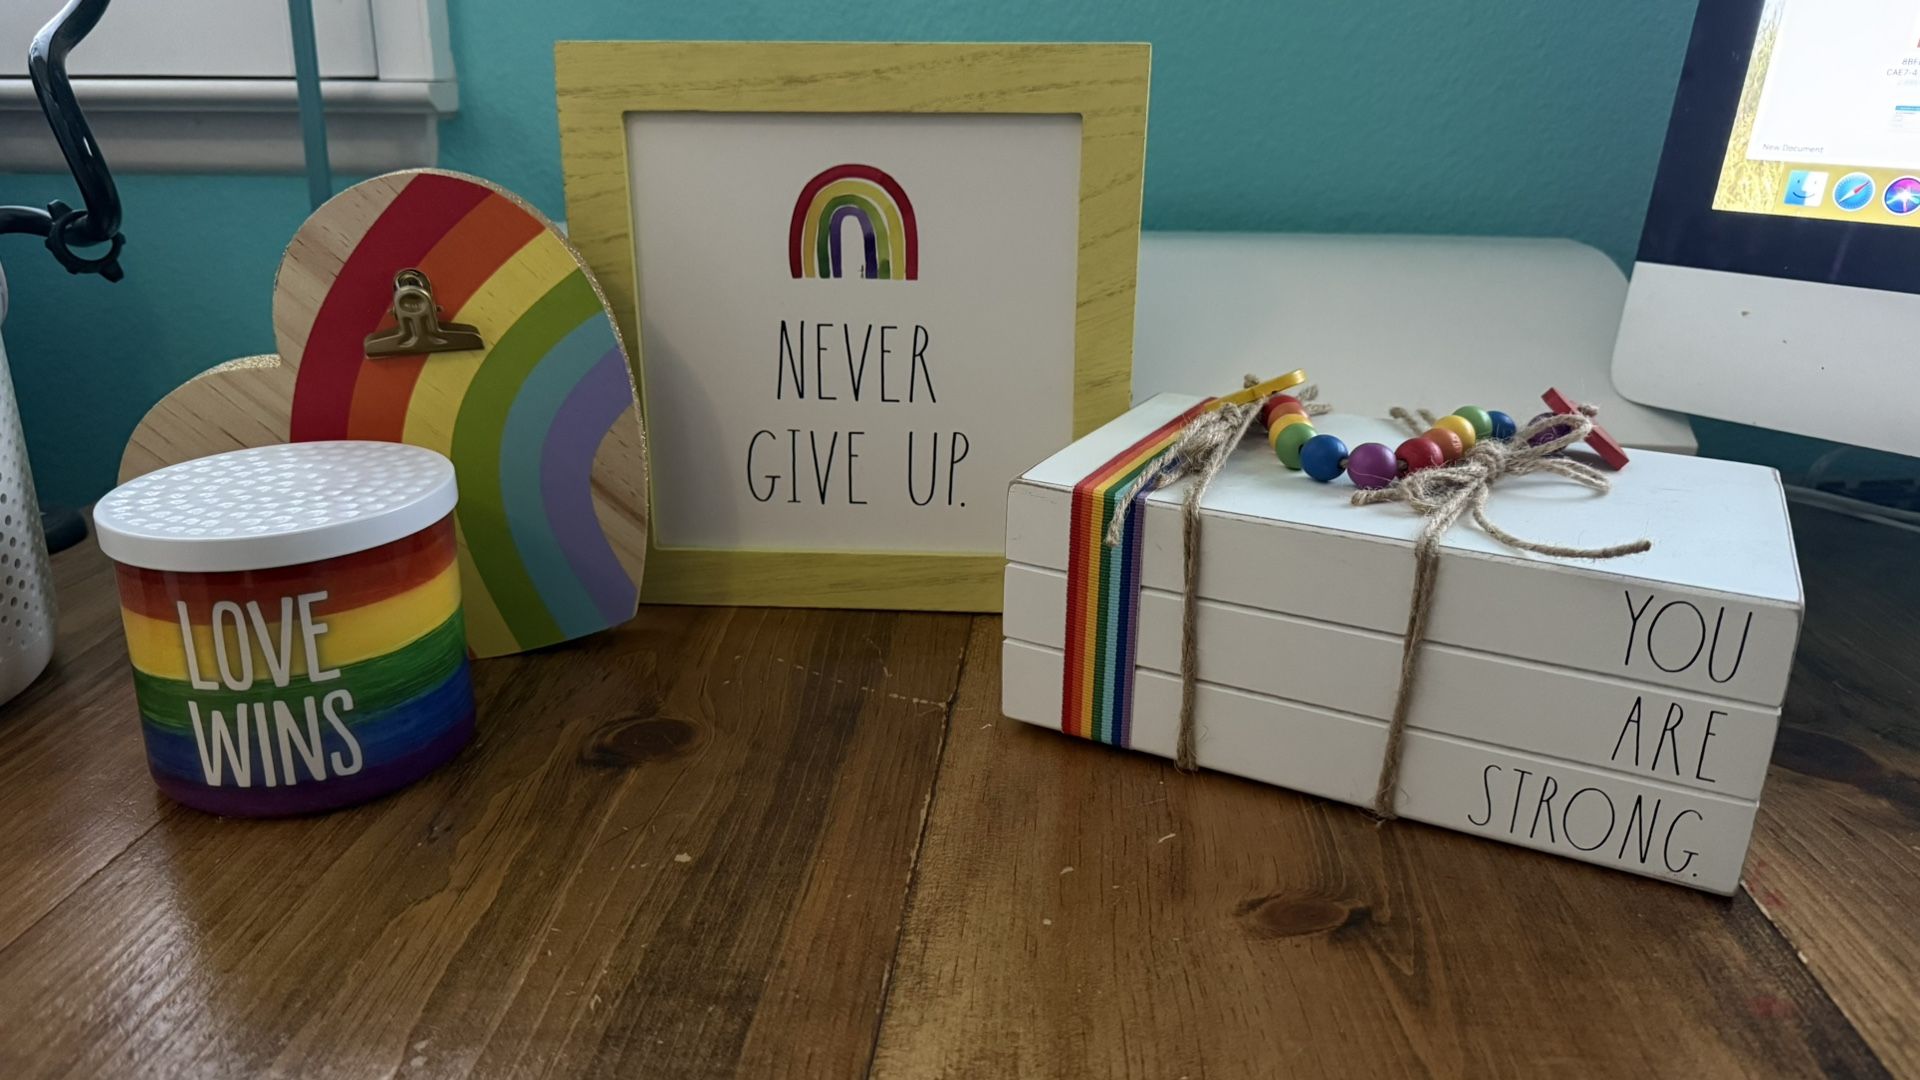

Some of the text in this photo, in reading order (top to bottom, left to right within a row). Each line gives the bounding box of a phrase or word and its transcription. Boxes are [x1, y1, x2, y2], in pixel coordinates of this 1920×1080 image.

[1762, 143, 1825, 154] New Document
[776, 320, 937, 403] NEVER
[747, 429, 970, 506] GIVE UP.
[176, 590, 341, 691] LOVE
[1625, 590, 1753, 683] YOU
[187, 689, 363, 788] WINS
[1611, 696, 1729, 783] ARE
[1467, 764, 1704, 878] STRONG.
